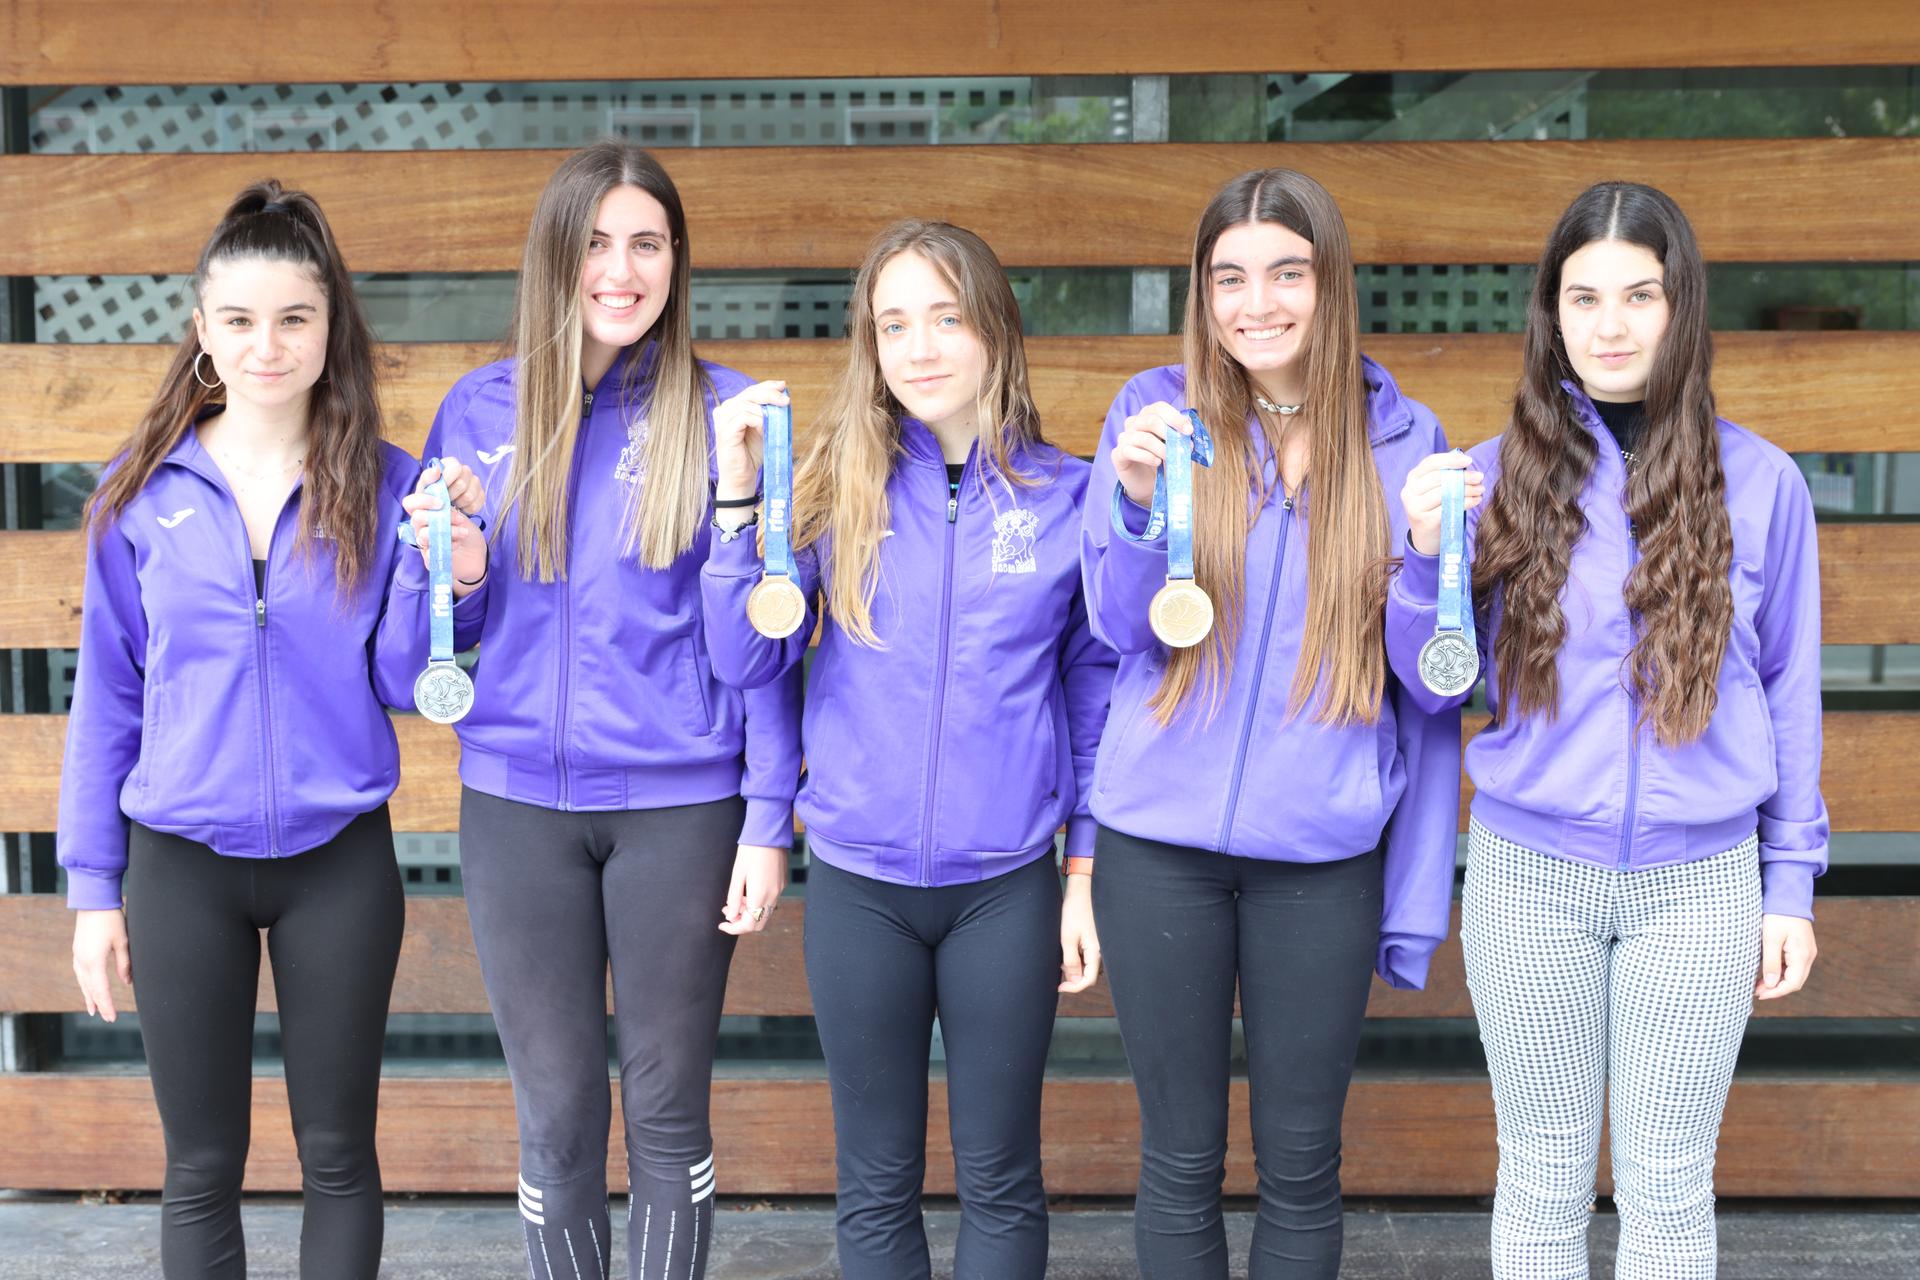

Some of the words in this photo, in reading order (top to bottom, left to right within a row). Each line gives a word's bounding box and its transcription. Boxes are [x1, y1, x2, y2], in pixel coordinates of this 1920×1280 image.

[768, 499, 785, 532] rfeg
[1442, 553, 1461, 588] rfeg
[432, 584, 450, 617] rfeg
